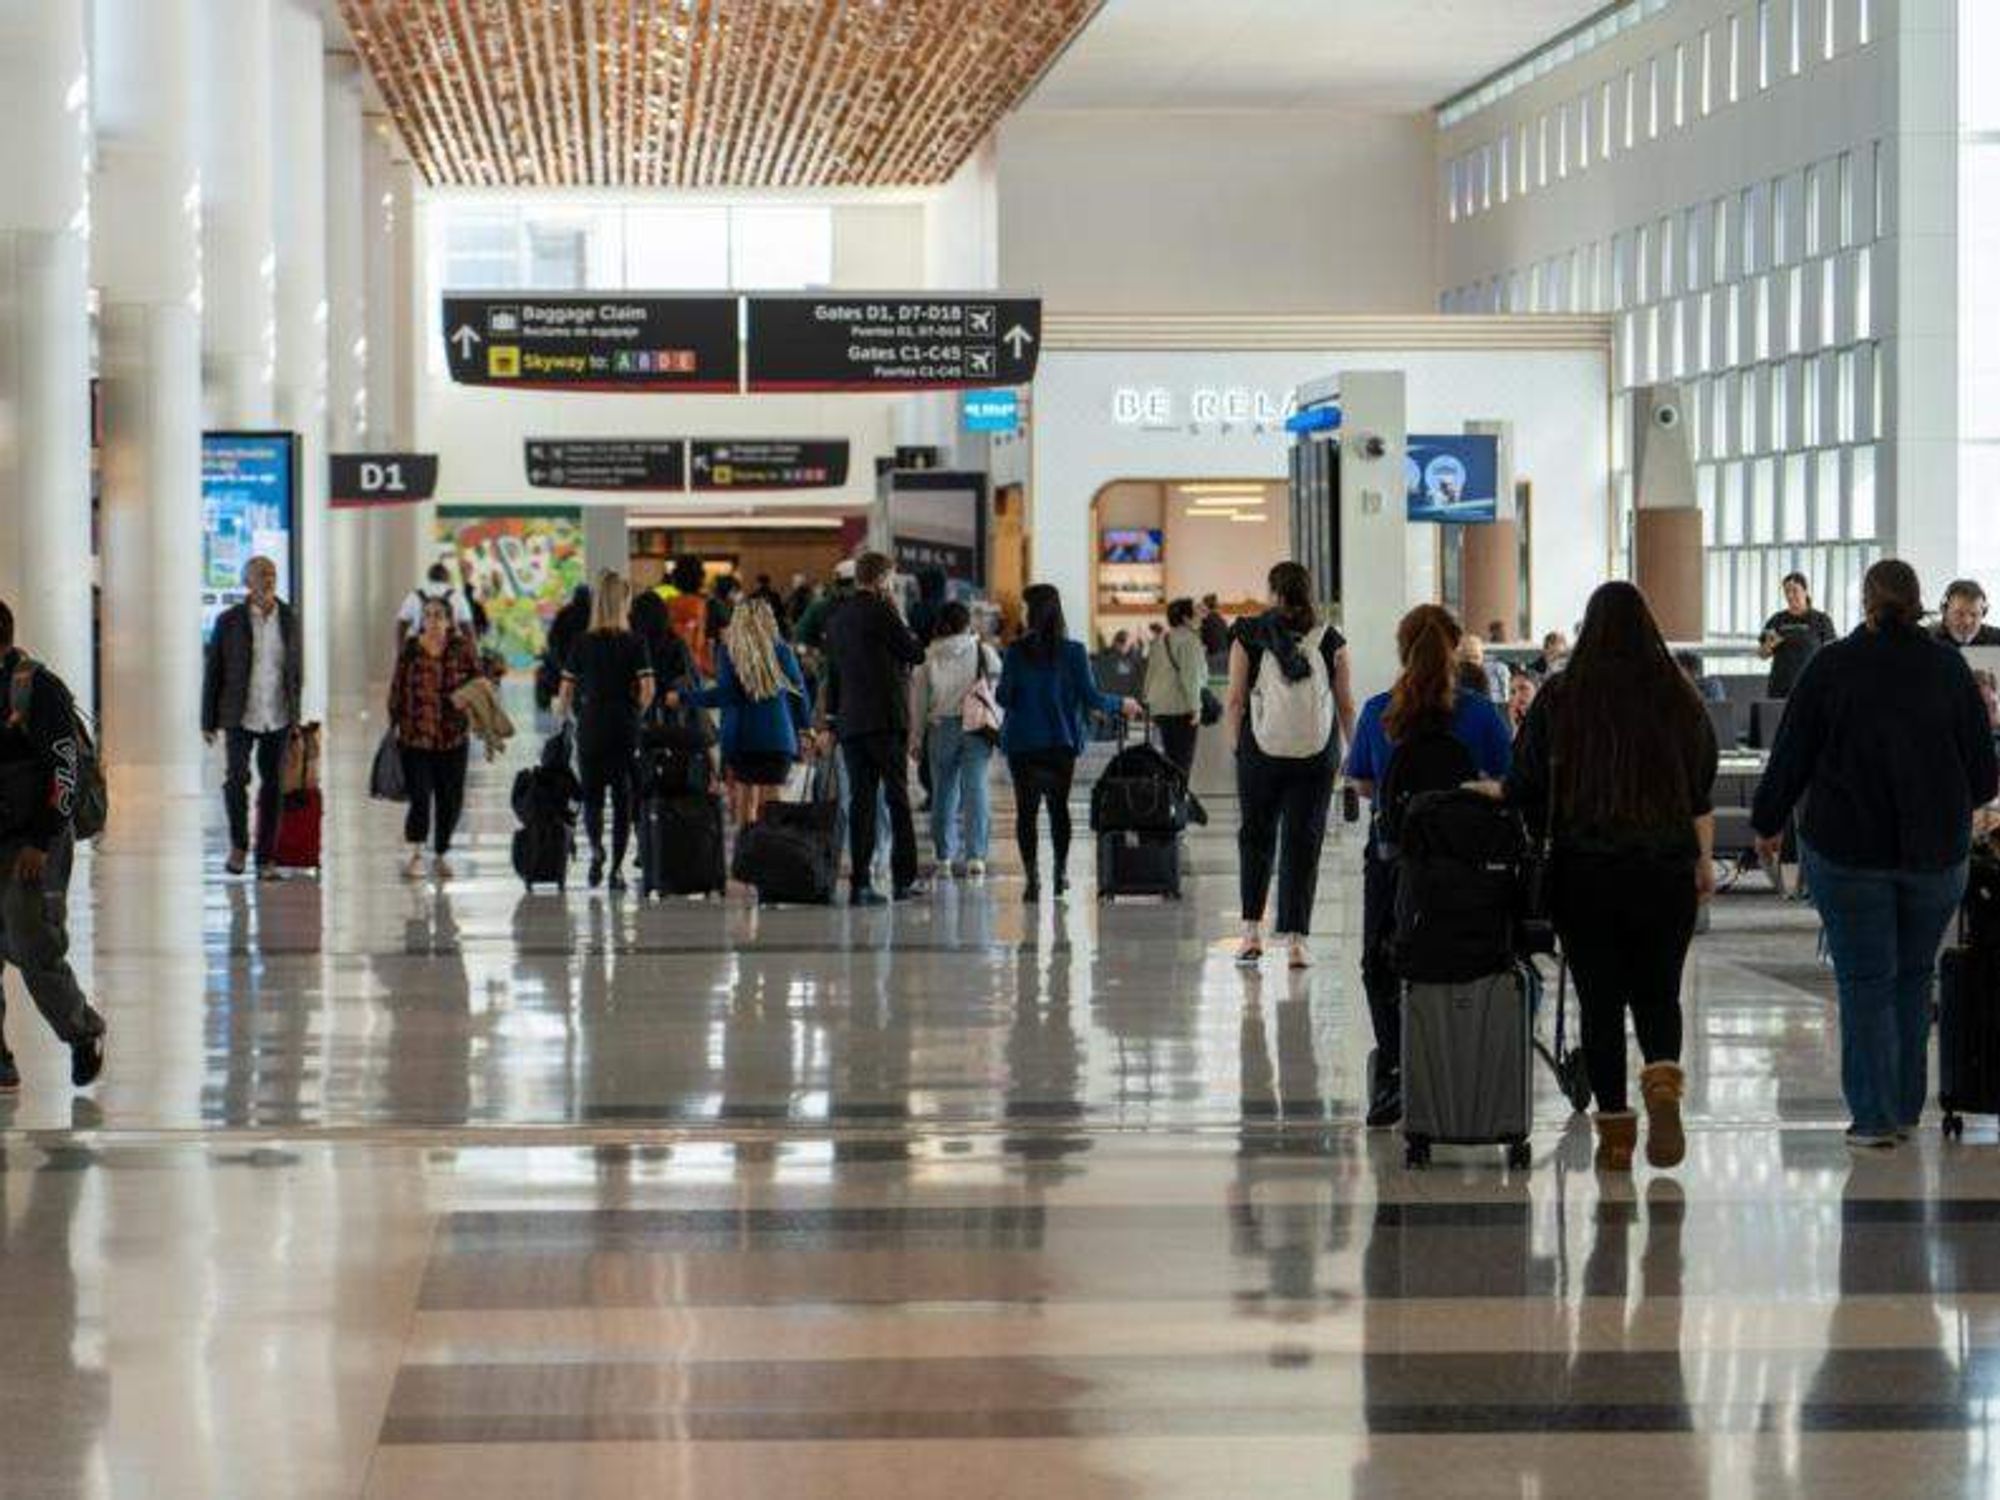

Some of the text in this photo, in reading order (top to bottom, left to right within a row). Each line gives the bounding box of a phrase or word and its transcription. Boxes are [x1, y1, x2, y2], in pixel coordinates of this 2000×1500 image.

[522, 305, 647, 324] Baggage Claim
[815, 305, 861, 320] Gates
[866, 305, 895, 322] D1,
[523, 354, 585, 372] Skyway
[618, 352, 630, 369] A
[848, 345, 896, 360] Gates
[1115, 389, 1169, 422] BE
[360, 463, 404, 490] D1
